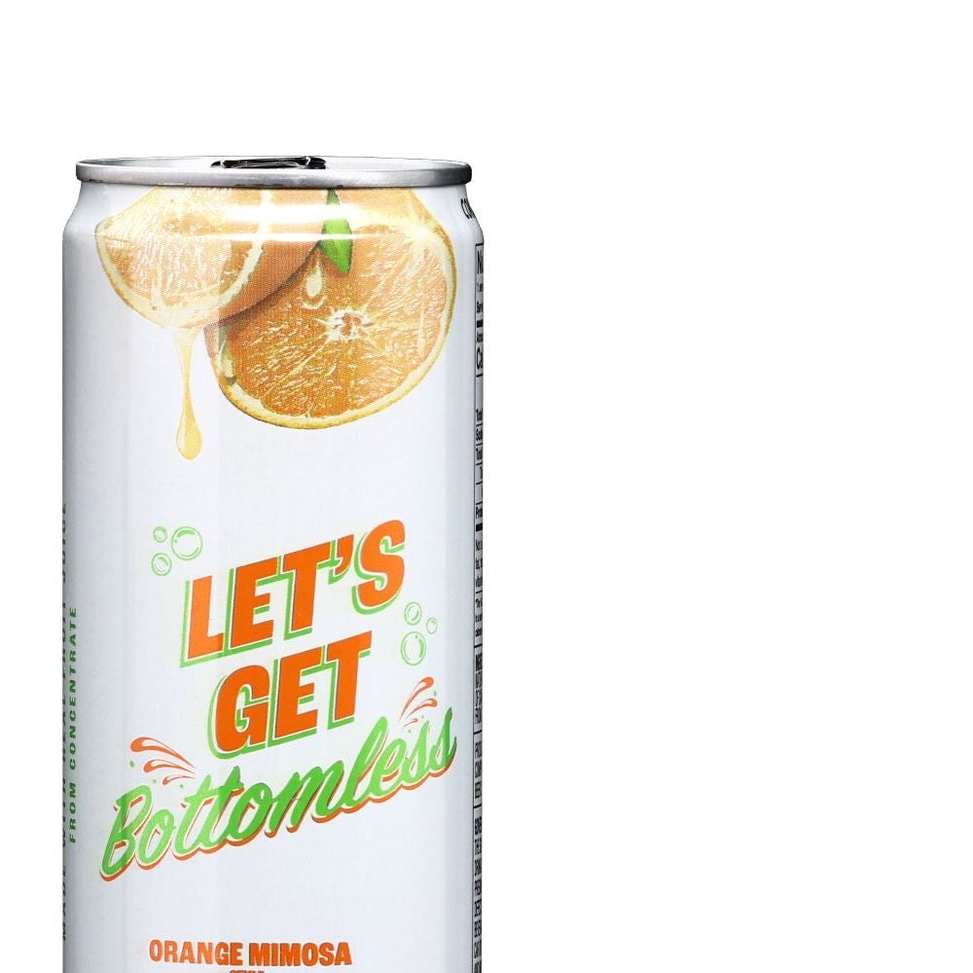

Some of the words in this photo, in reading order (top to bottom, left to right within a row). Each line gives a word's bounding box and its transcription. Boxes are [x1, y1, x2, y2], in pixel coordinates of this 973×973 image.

[180, 519, 406, 668] LET'S
[208, 630, 372, 759] GET
[99, 707, 457, 881] Bottomless
[149, 939, 243, 966] ORANGE
[249, 942, 352, 966] MIMOSA
